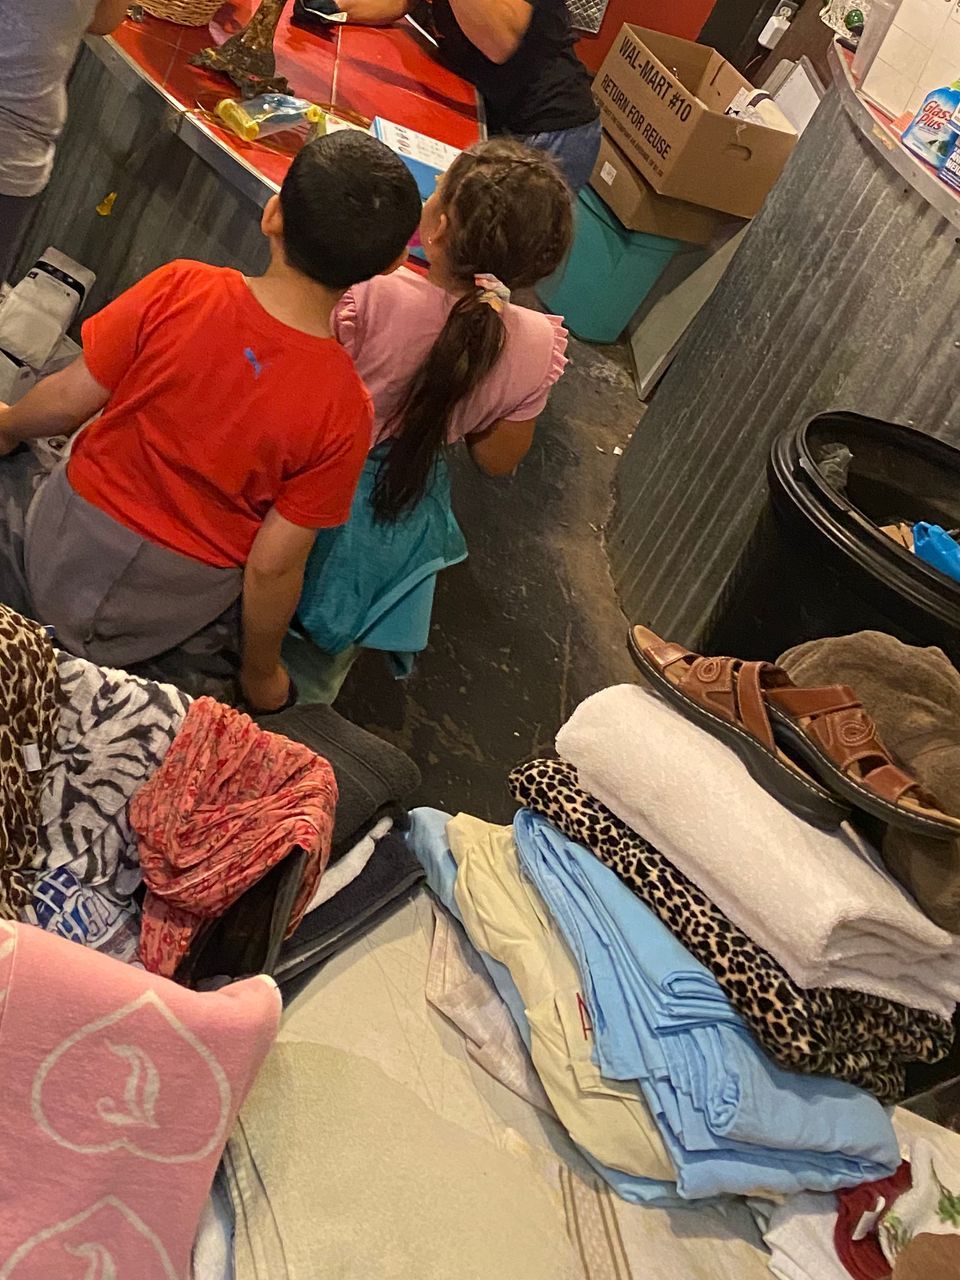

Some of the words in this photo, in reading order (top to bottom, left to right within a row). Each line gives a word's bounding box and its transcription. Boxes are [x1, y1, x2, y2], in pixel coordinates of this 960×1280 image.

[600, 73, 629, 113] RETURN
[626, 105, 642, 131] FOR
[642, 123, 672, 160] REUSE
[619, 36, 673, 101] WAL-MART
[668, 91, 692, 122] #10
[916, 113, 945, 130] Plus
